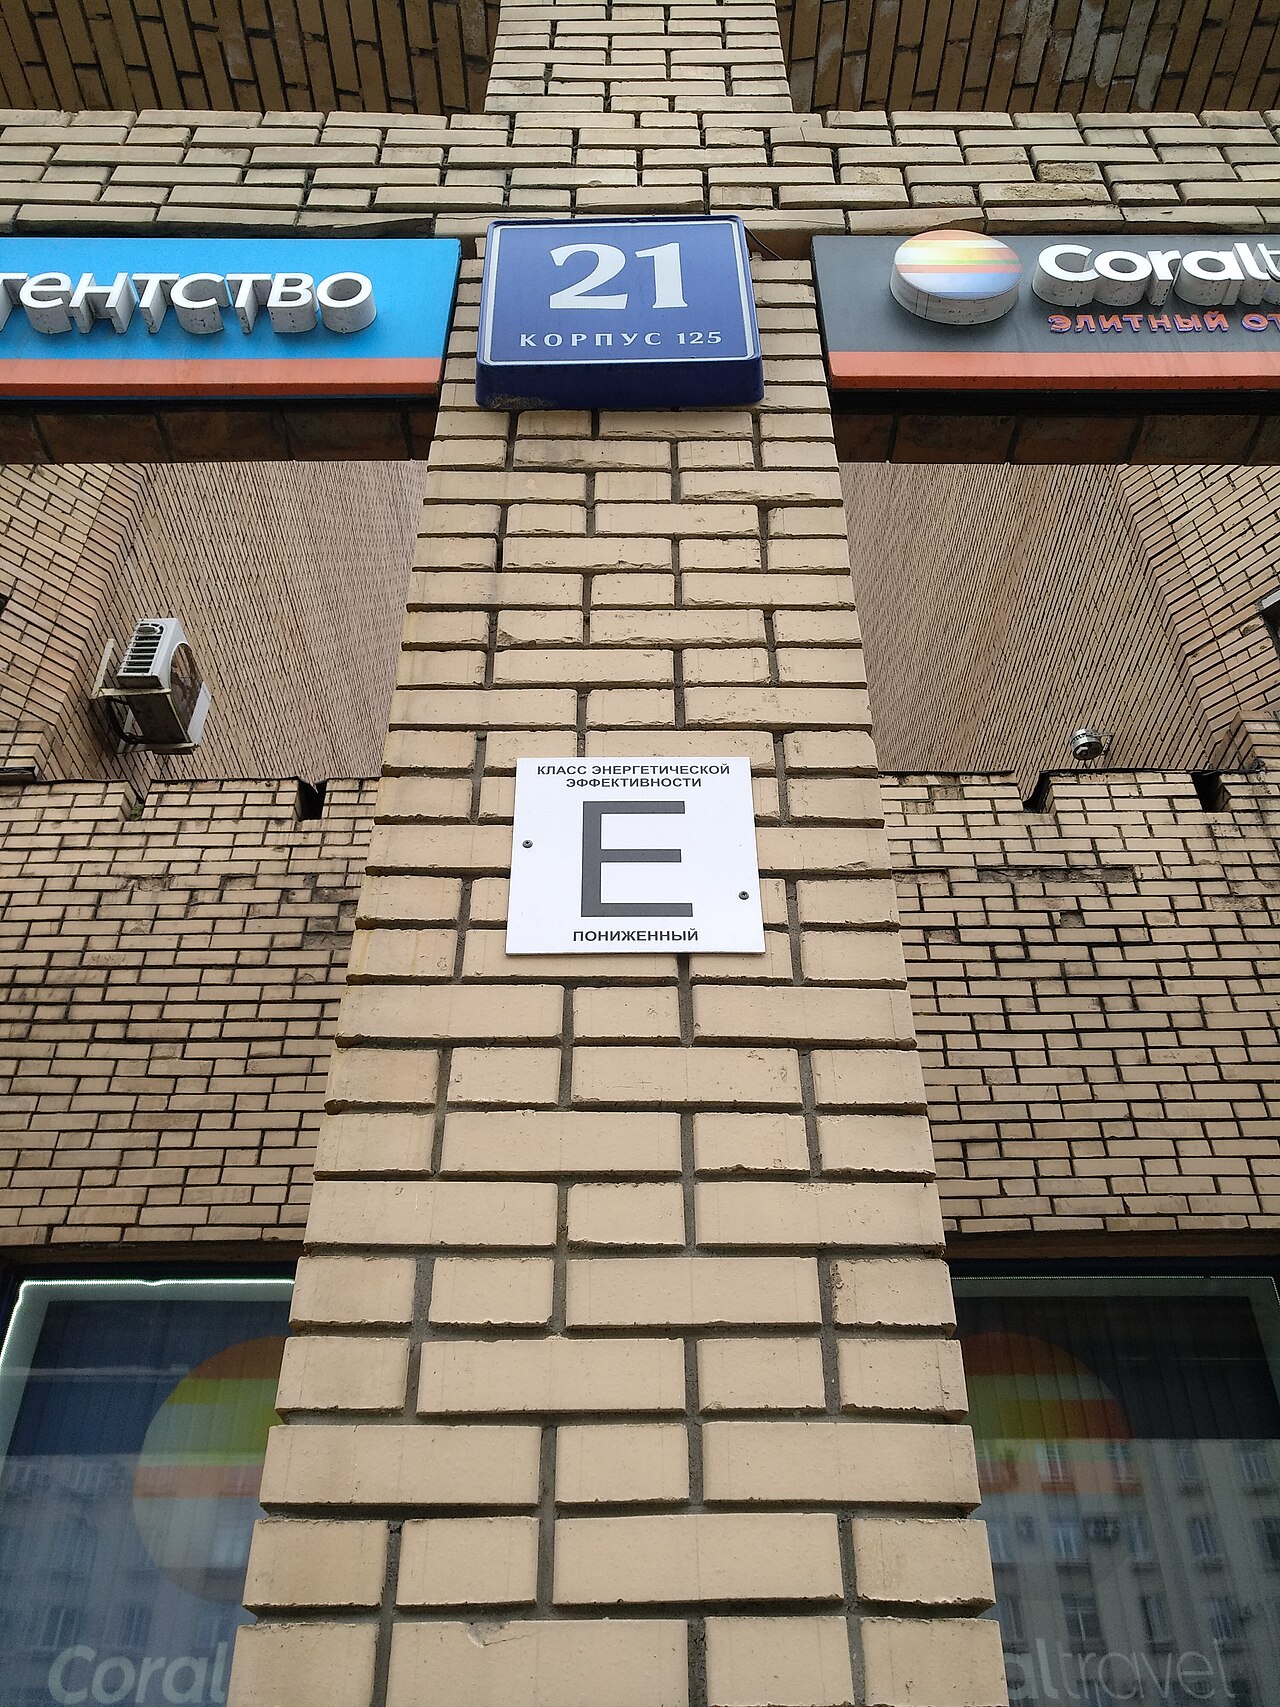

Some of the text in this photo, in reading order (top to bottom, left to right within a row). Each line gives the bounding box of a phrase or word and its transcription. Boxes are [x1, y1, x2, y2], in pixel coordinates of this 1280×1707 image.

[549, 242, 689, 310] 21
[519, 330, 723, 348] КОРПУС 125
[536, 763, 731, 776] КЛАСС ЭНЕРГЕТИЧЕСКОЙ
[565, 777, 702, 788] ЭФФЕКТИВНОСТИ
[572, 927, 699, 942] ПОНИЖЕННЫЙ
[48, 1640, 230, 1704] Coral
